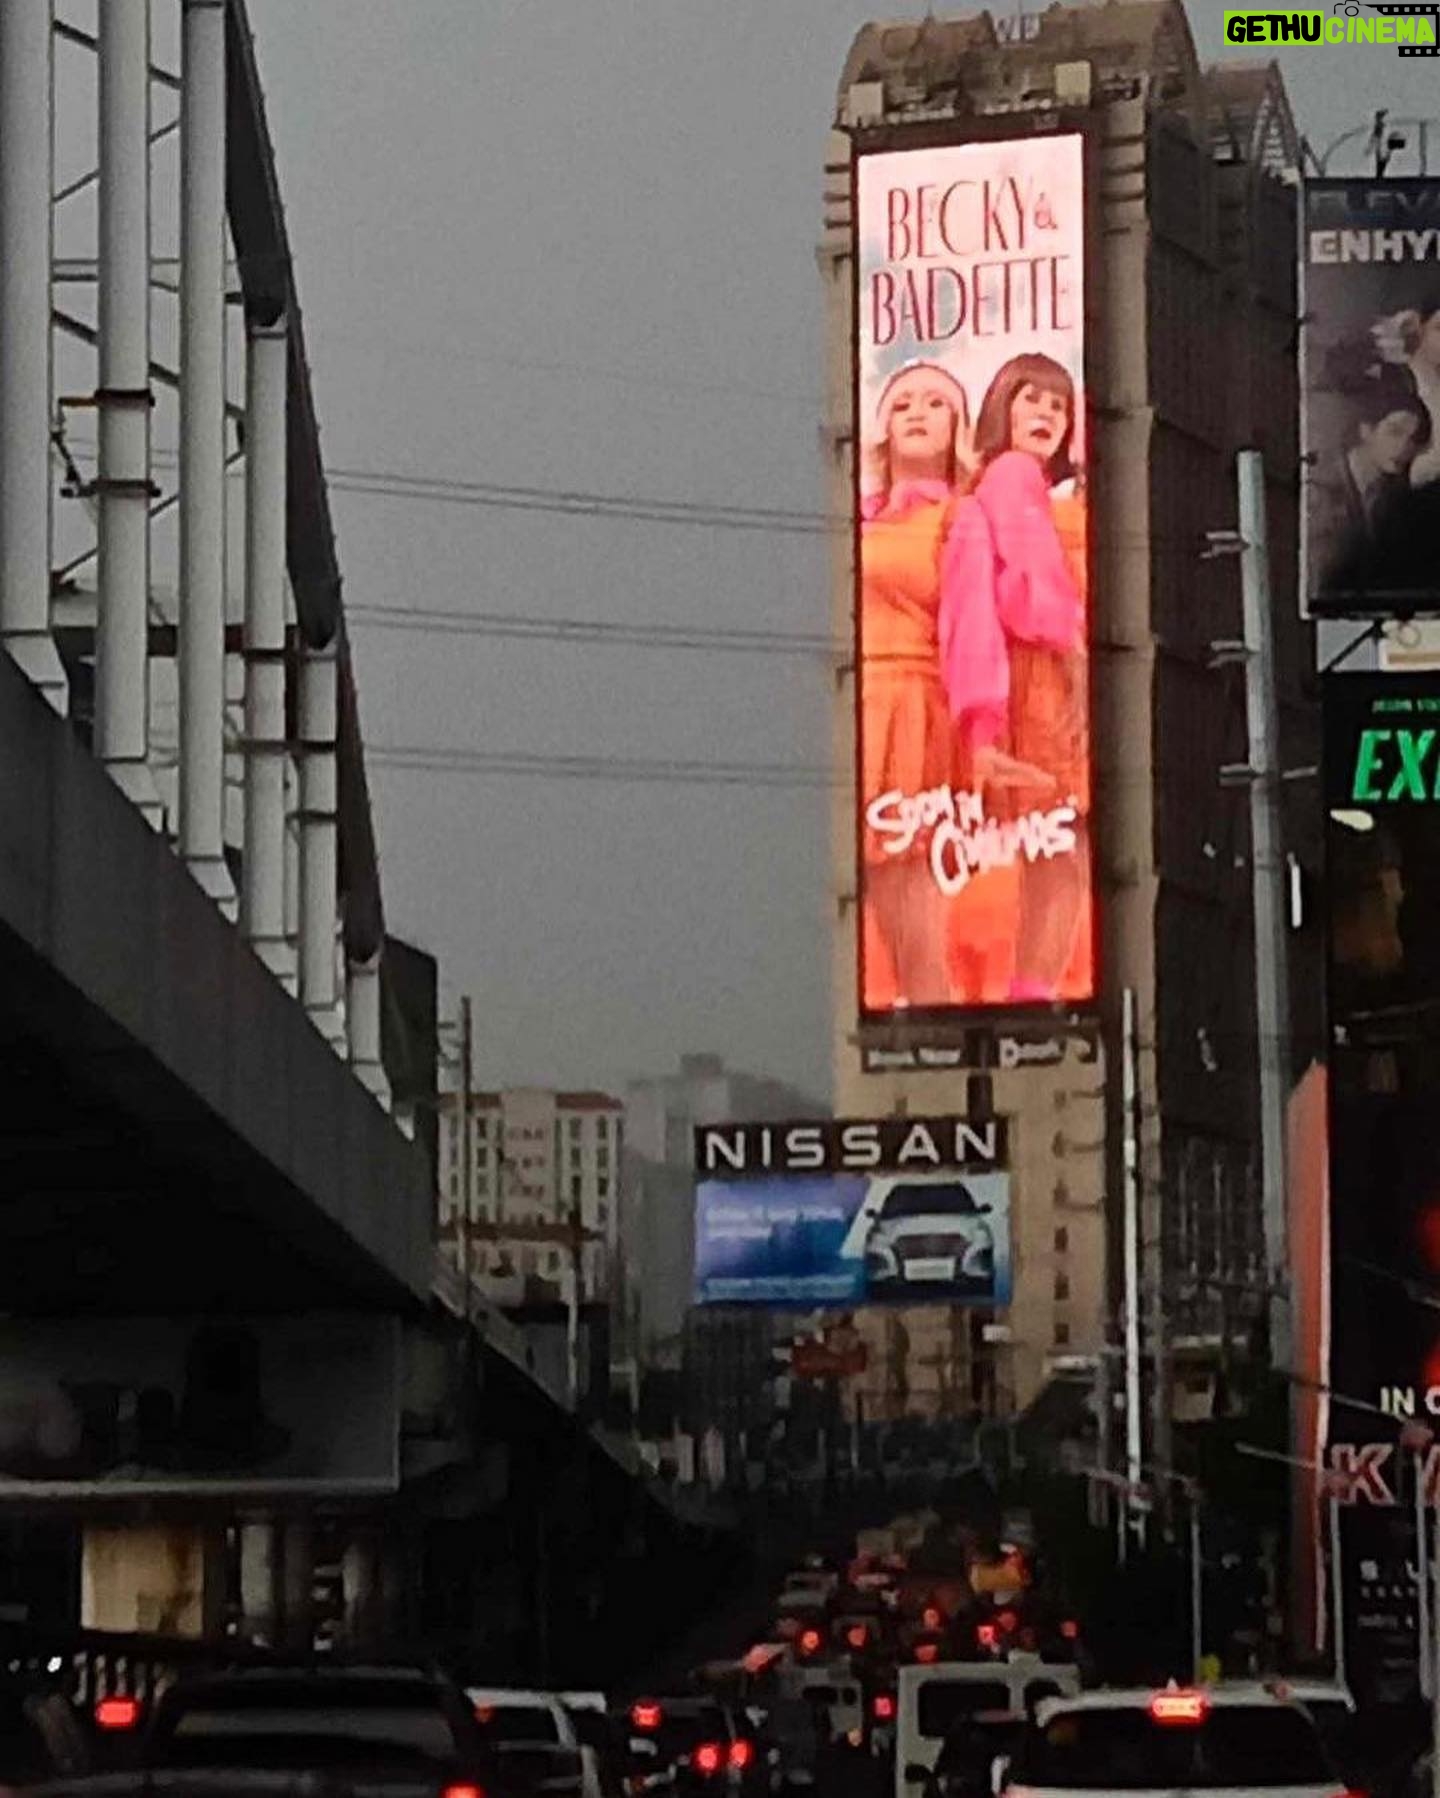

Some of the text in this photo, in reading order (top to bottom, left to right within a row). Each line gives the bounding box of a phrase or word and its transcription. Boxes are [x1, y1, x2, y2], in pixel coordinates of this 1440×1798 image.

[888, 177, 1030, 262] BECKY
[1310, 230, 1440, 263] ENHY
[872, 255, 1072, 346] BADETTE
[1353, 730, 1440, 800] EX
[706, 1122, 996, 1170] NISSAN
[1380, 1386, 1415, 1416] IN
